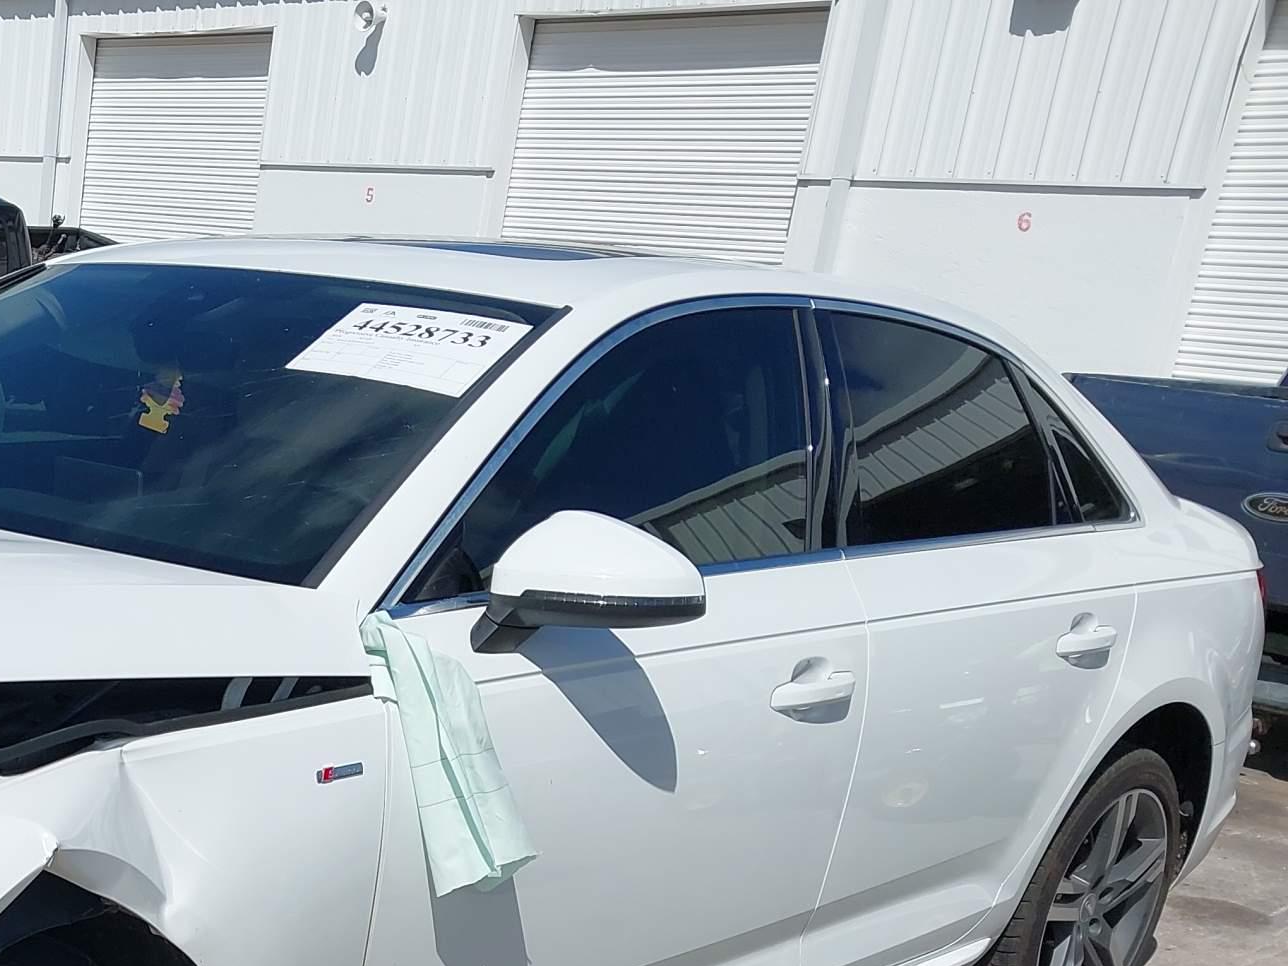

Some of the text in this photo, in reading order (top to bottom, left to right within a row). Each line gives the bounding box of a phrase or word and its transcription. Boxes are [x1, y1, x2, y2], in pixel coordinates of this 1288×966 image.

[365, 187, 374, 203] 5
[1017, 211, 1033, 232] 6
[352, 319, 491, 348] 44528733
